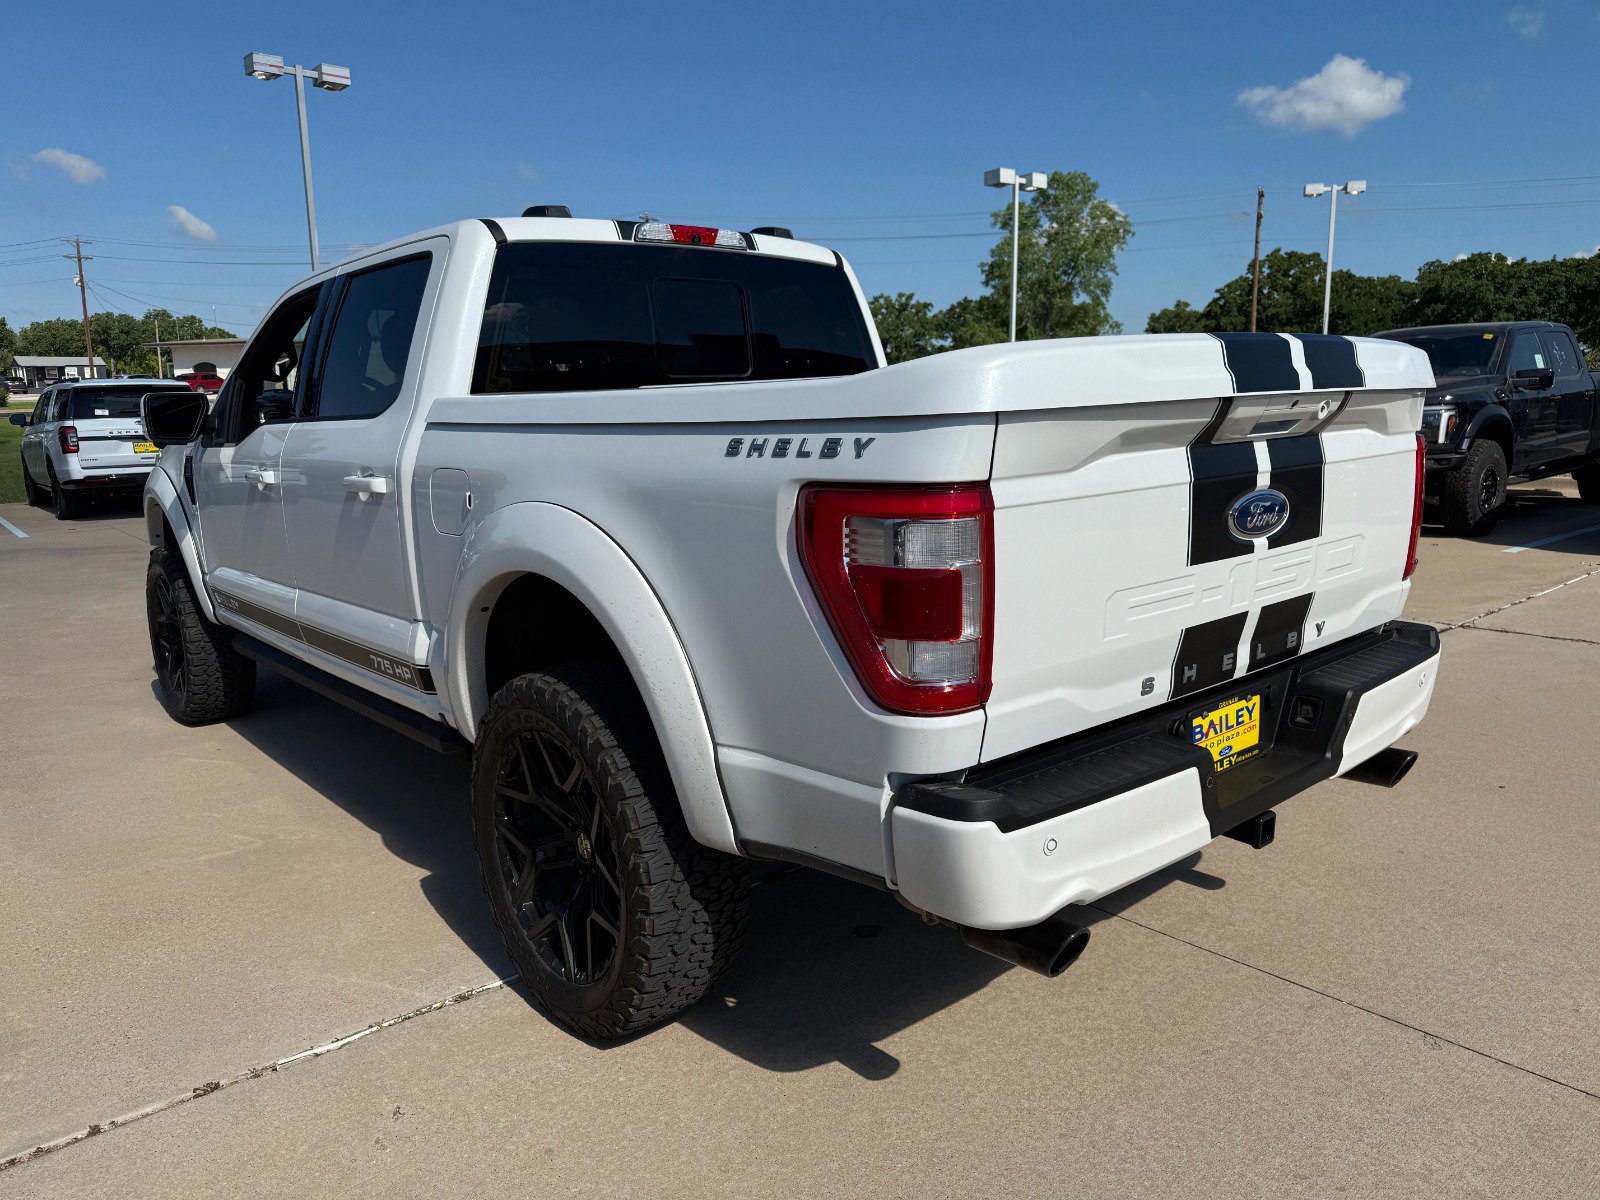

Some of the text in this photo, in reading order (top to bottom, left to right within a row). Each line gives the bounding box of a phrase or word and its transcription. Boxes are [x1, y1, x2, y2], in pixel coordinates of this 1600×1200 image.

[724, 437, 877, 459] SHELBY
[1246, 501, 1280, 530] Ford
[370, 654, 412, 680] 775 HP
[1140, 620, 1326, 697] SHELBY
[1193, 701, 1257, 744] BAILEY
[1205, 723, 1257, 749] toplaza.com
[1214, 754, 1237, 772] ILEY
